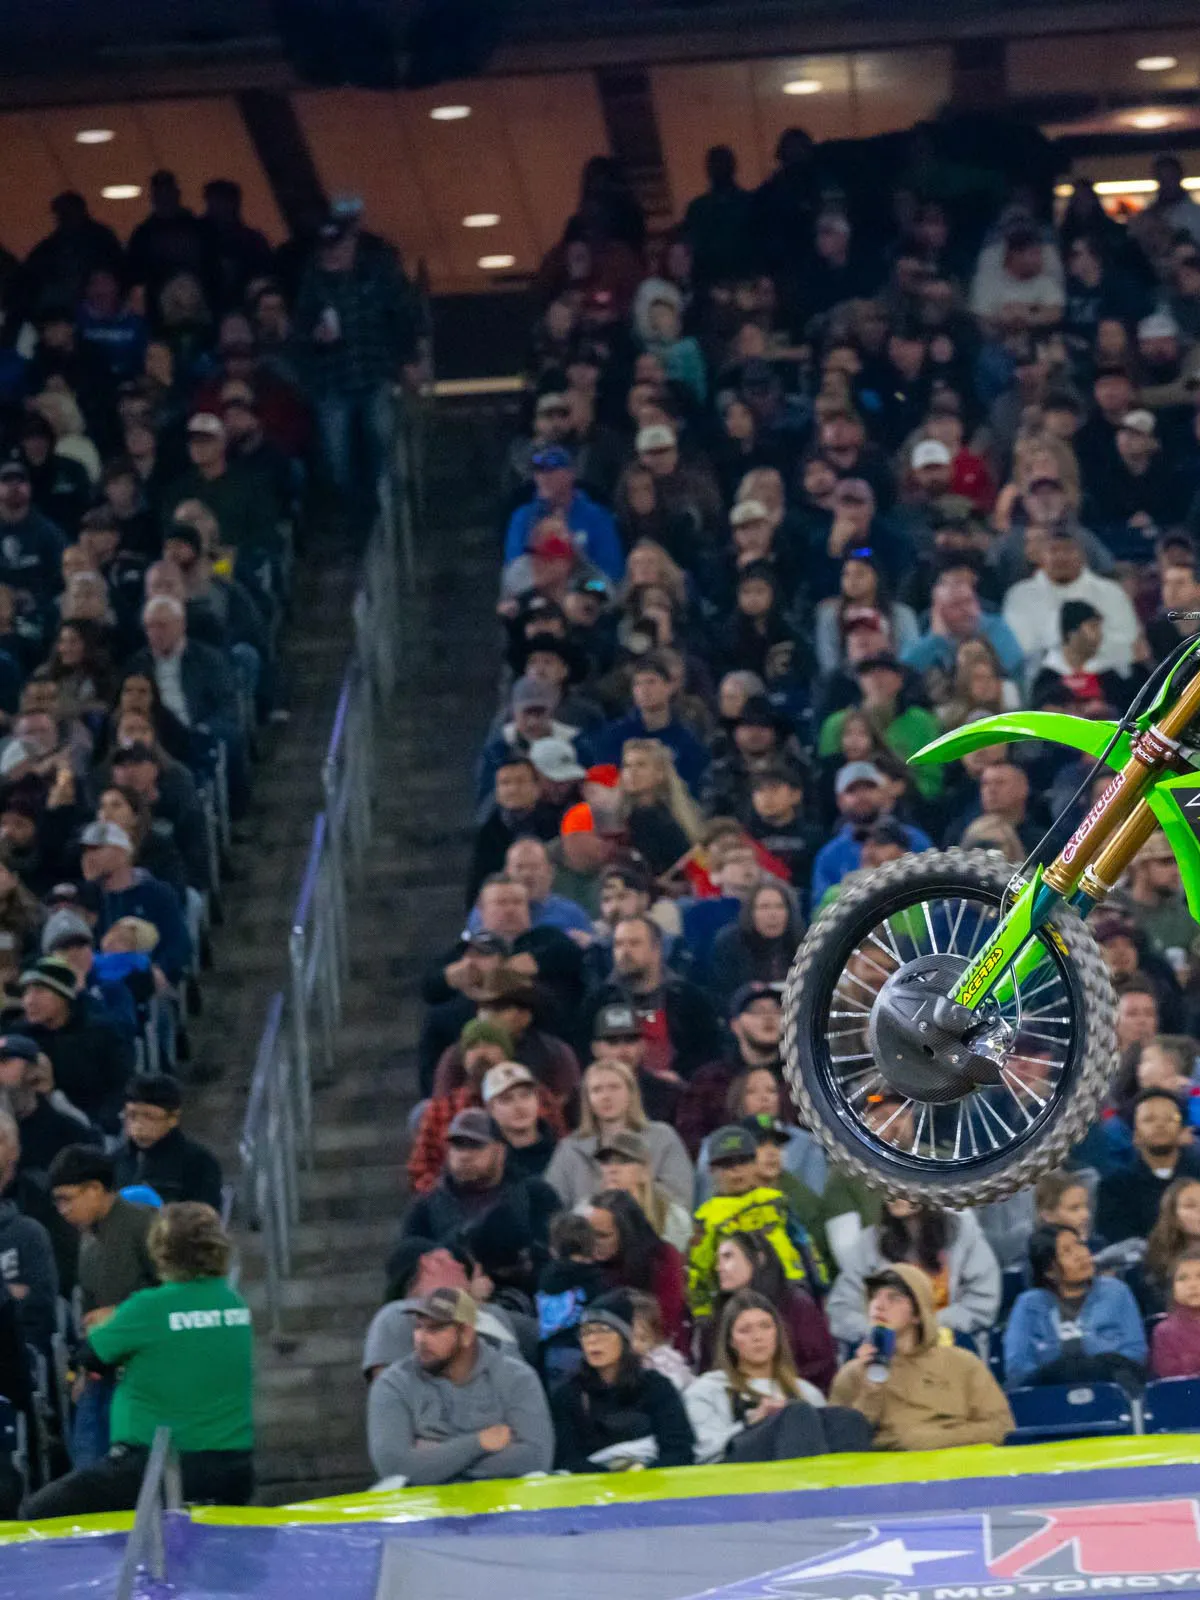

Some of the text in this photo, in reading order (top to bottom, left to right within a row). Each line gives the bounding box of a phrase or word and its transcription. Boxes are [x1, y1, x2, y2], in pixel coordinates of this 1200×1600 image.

[1075, 770, 1127, 840] SHOWA
[962, 947, 1003, 1005] ACERBIS
[169, 1309, 221, 1331] EVENT
